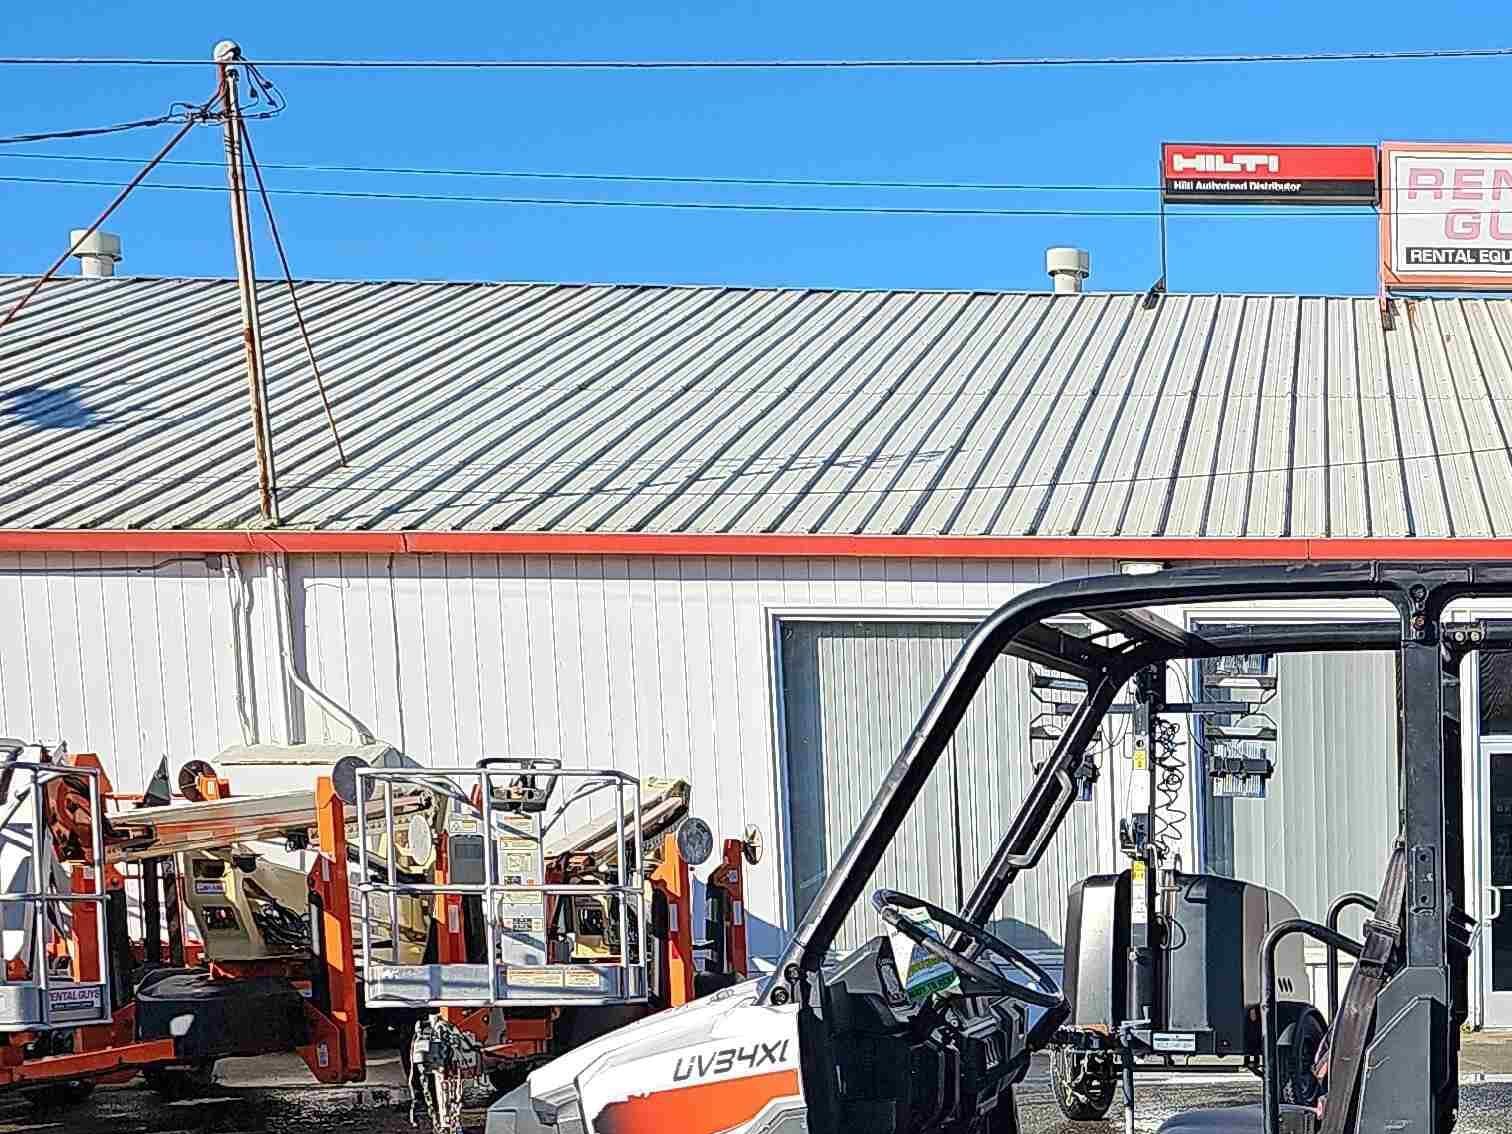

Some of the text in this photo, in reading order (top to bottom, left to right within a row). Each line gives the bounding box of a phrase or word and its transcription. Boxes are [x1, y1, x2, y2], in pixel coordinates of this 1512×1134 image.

[1172, 154, 1280, 172] HILTI
[1195, 181, 1248, 191] Authorized
[1249, 181, 1301, 192] Distributor
[1410, 248, 1476, 264] RENTAL
[673, 1039, 790, 1082] UV34XL
